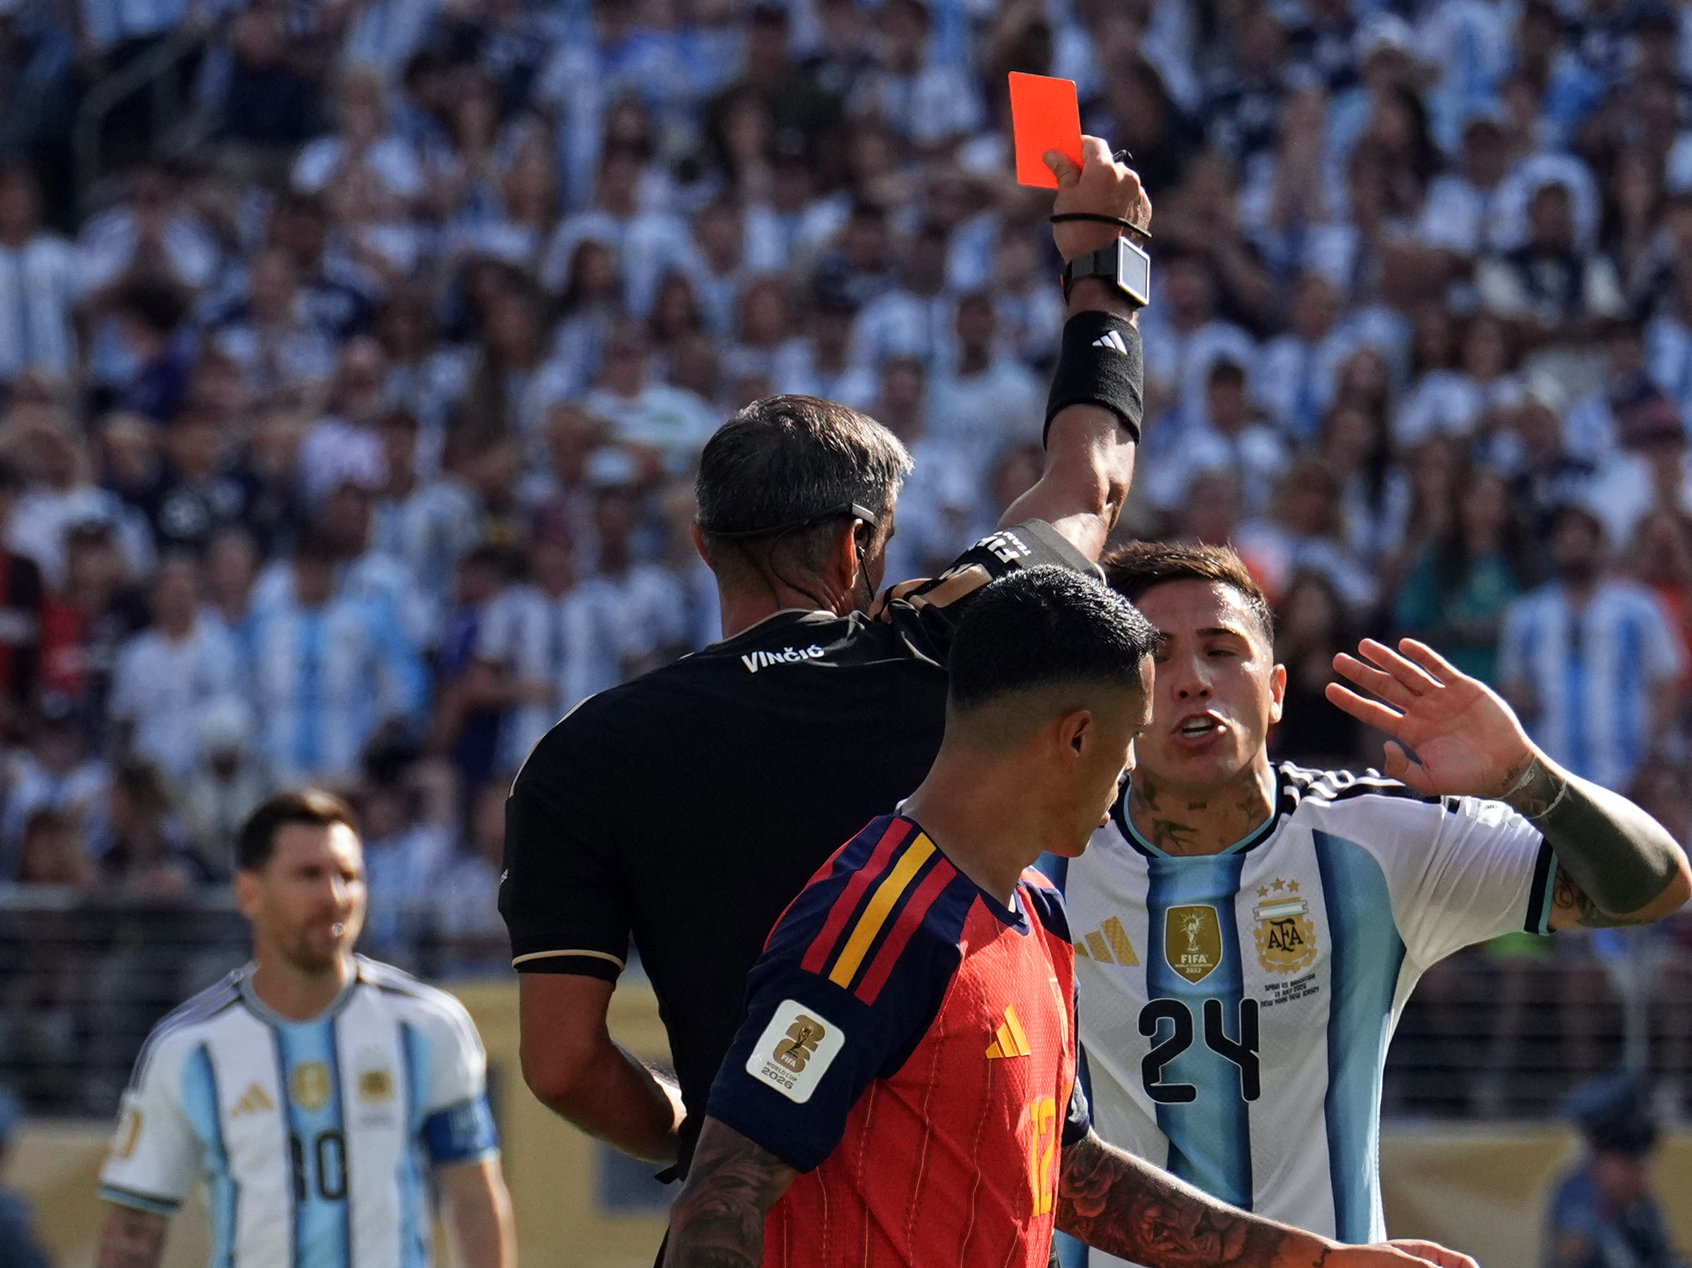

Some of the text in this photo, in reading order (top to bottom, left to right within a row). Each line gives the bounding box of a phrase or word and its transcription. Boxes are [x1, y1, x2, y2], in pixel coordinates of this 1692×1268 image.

[741, 643, 824, 674] VINČIĆ
[1267, 917, 1304, 952] AFA
[1180, 954, 1208, 964] FIFA
[780, 1054, 797, 1068] FIFA
[1138, 997, 1262, 1104] 24
[760, 1066, 795, 1090] 2026
[766, 1060, 798, 1082] WORLD CUP
[289, 1131, 348, 1201] 10
[1030, 1097, 1056, 1217] 12
